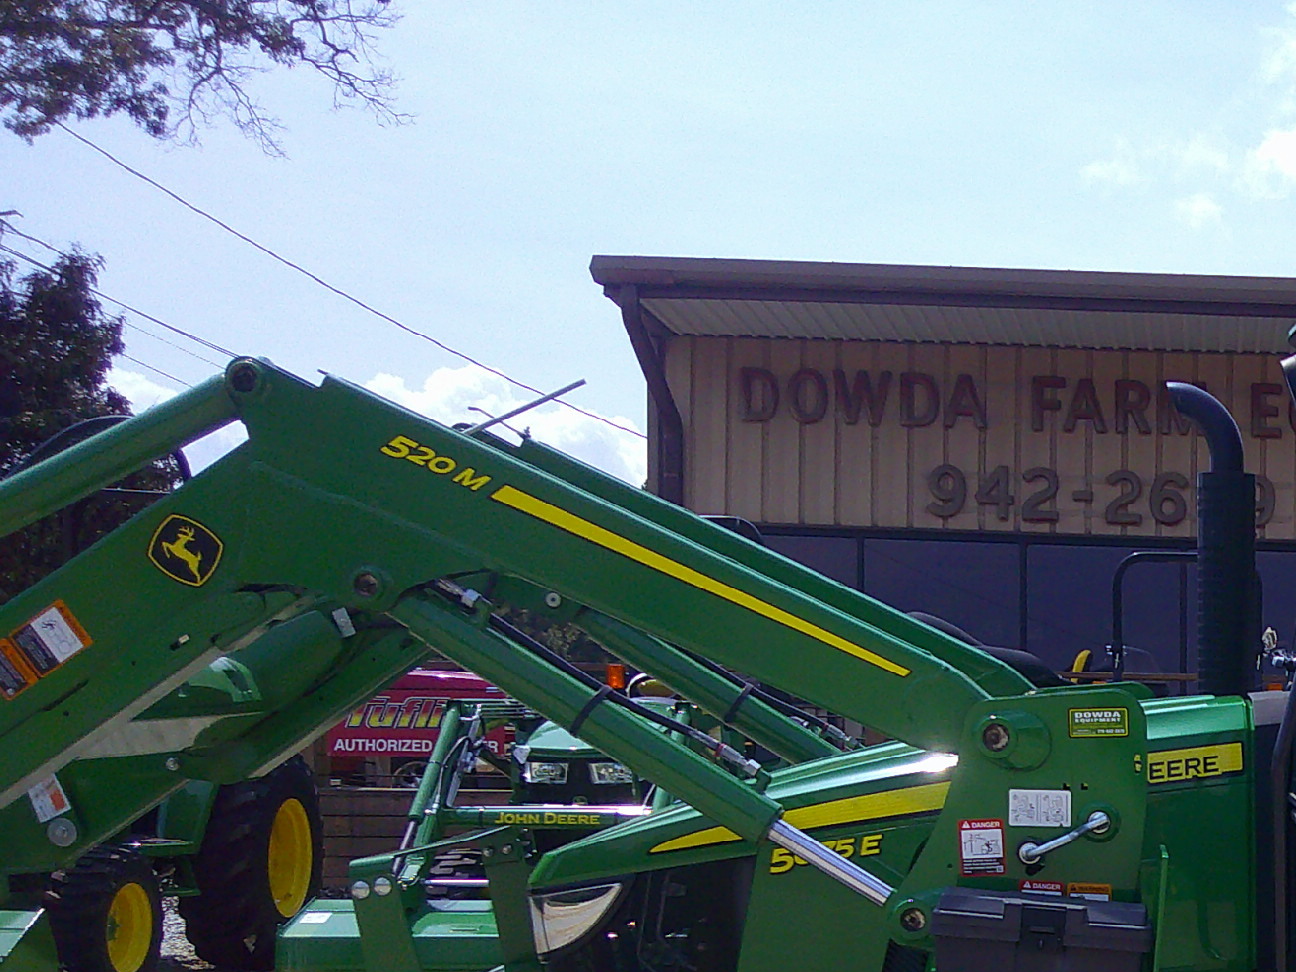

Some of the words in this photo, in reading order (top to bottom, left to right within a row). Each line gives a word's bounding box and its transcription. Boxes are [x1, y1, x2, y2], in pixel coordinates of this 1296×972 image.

[739, 366, 988, 429] DOWDA
[1029, 375, 1208, 438] FARM
[380, 435, 457, 474] 520
[452, 467, 493, 492] M
[925, 462, 1276, 529] 942-269
[1074, 711, 1121, 719] DOWDA
[333, 738, 433, 753] AUTHORIZED
[1149, 755, 1220, 781] EERE
[494, 811, 540, 825] JOHN
[543, 811, 601, 825] DEERE
[971, 821, 1001, 829] DANGER
[769, 838, 856, 874] 575
[860, 834, 883, 856] E
[1032, 882, 1061, 890] DANGER
